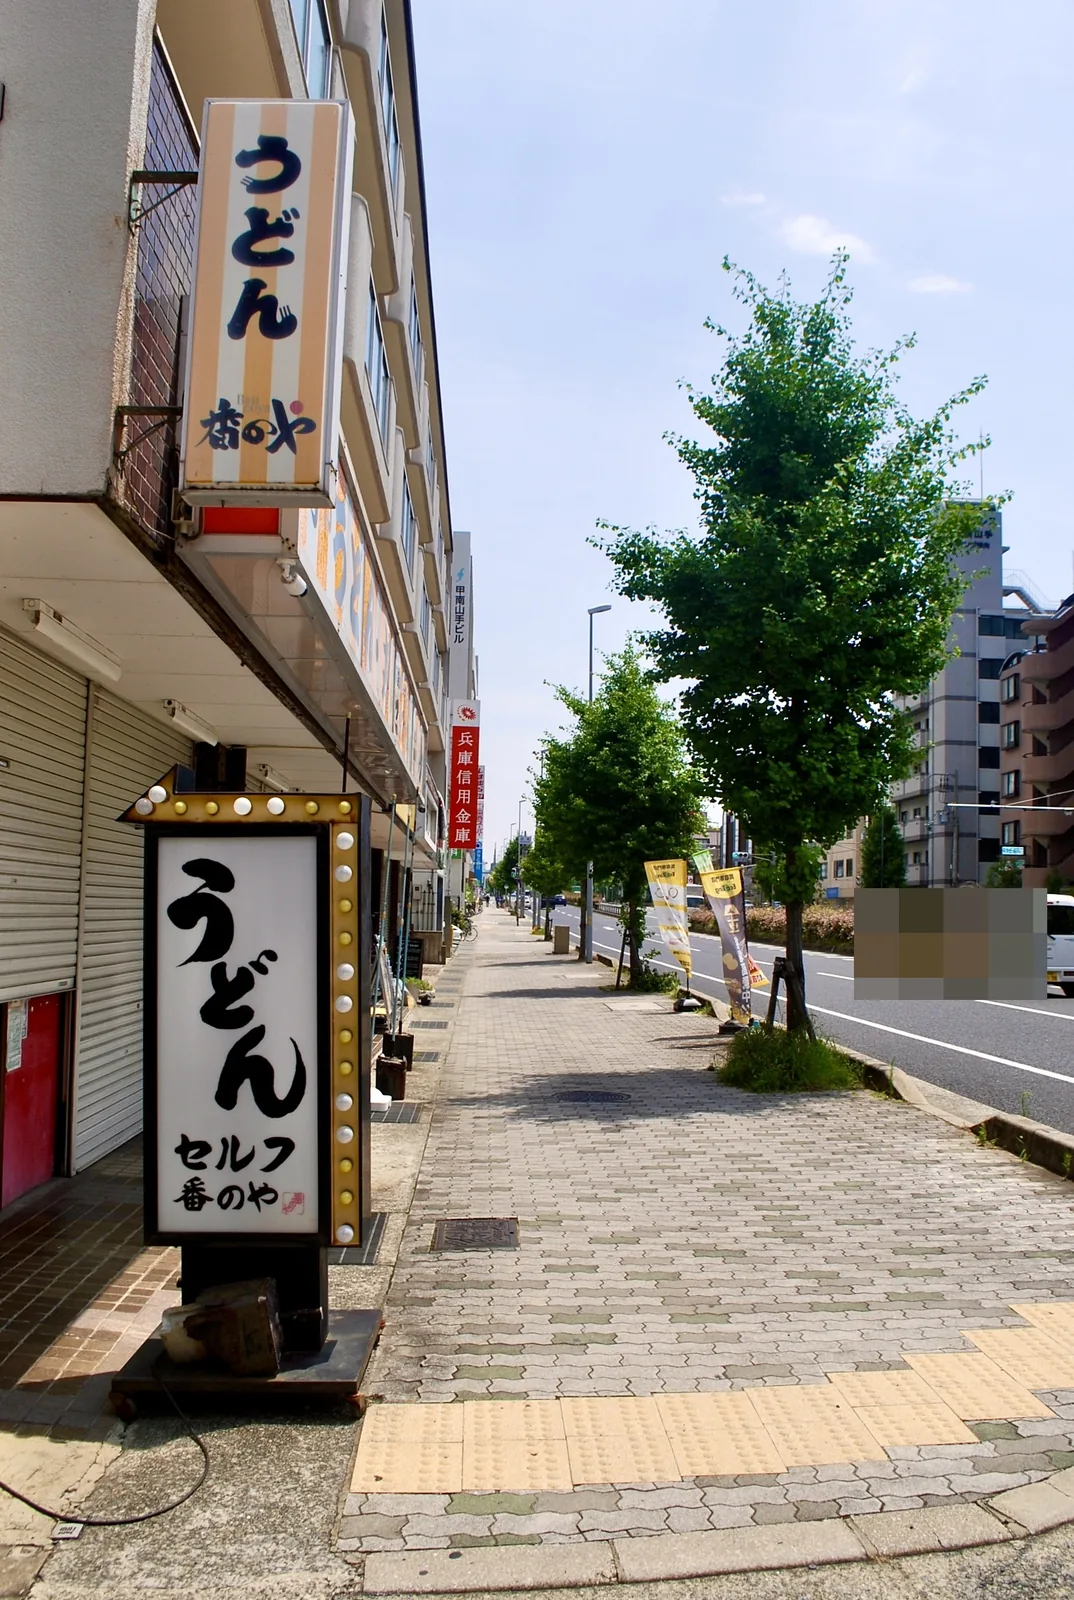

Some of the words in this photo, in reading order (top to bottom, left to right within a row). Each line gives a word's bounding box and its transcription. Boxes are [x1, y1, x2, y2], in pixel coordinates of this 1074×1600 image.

[227, 133, 302, 341] うどん
[196, 397, 317, 456] 番のや
[453, 585, 466, 644] 甲南山手ビル
[454, 731, 474, 843] 兵庫信用金庫
[166, 857, 307, 1119] うどん
[173, 1133, 296, 1174] セルフ
[172, 1176, 279, 1214] 番のや
